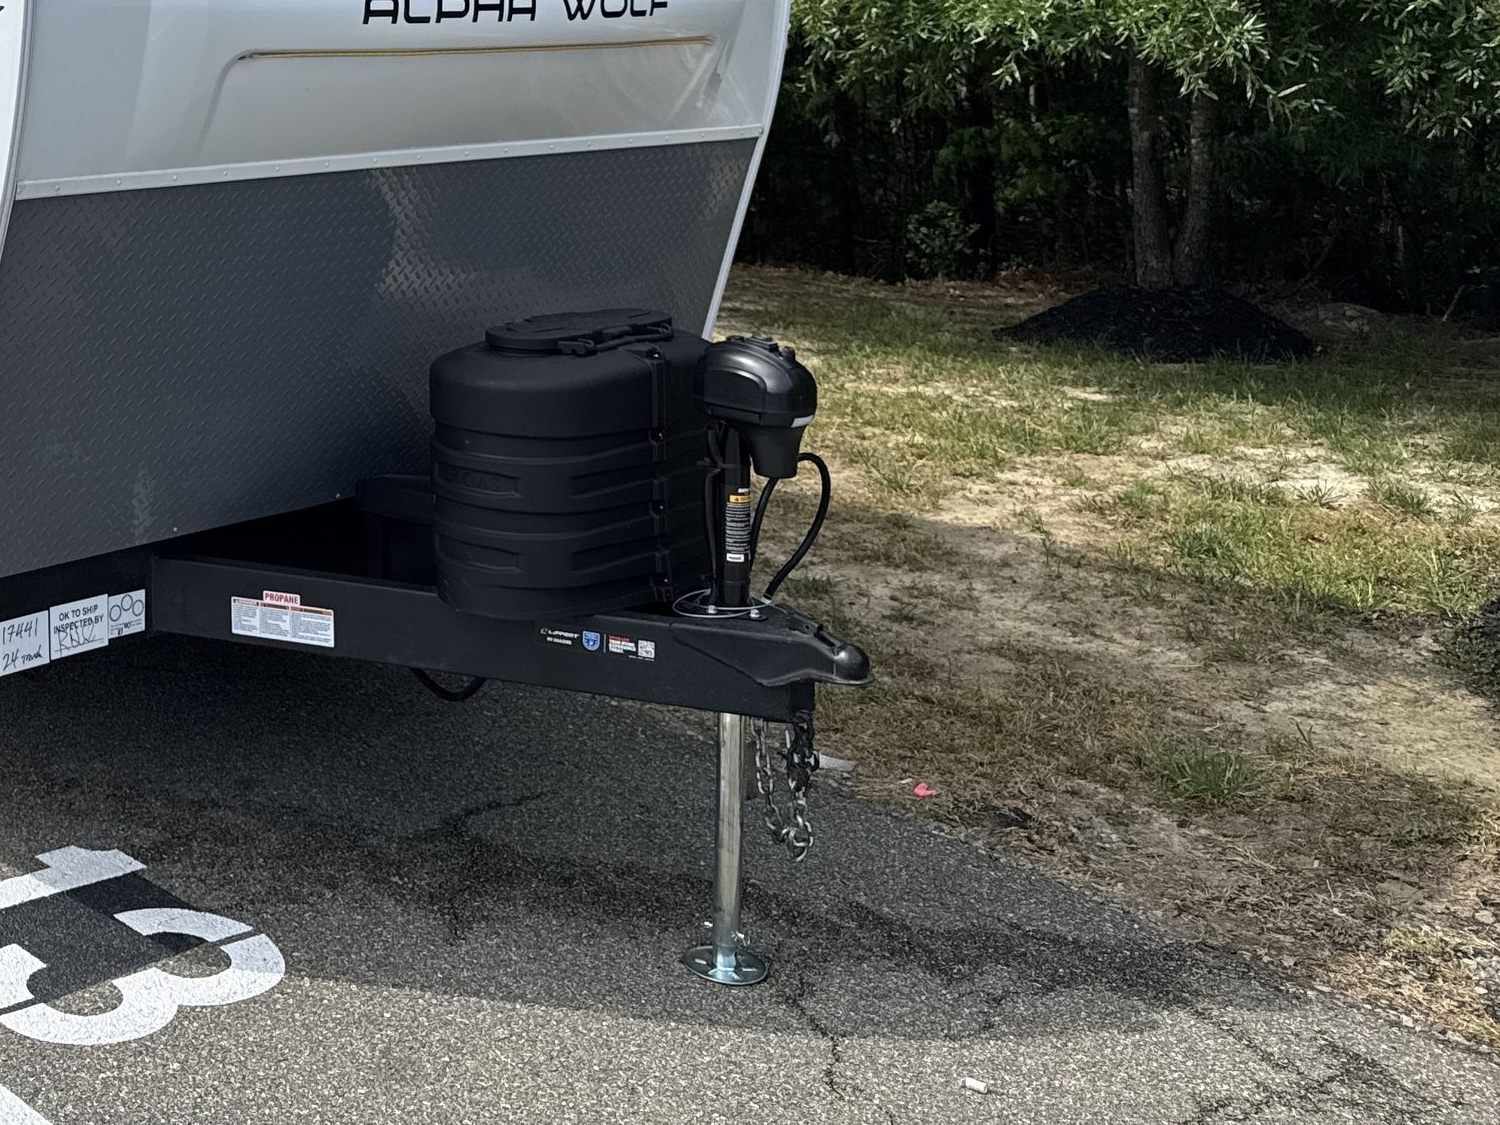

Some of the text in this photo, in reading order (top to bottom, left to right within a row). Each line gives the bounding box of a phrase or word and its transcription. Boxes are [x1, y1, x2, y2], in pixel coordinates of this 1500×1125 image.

[264, 592, 299, 604] PROPANE
[58, 604, 99, 622] OK TO SHIP
[2, 618, 39, 645] 17441
[53, 614, 104, 635] INSPECTED BY
